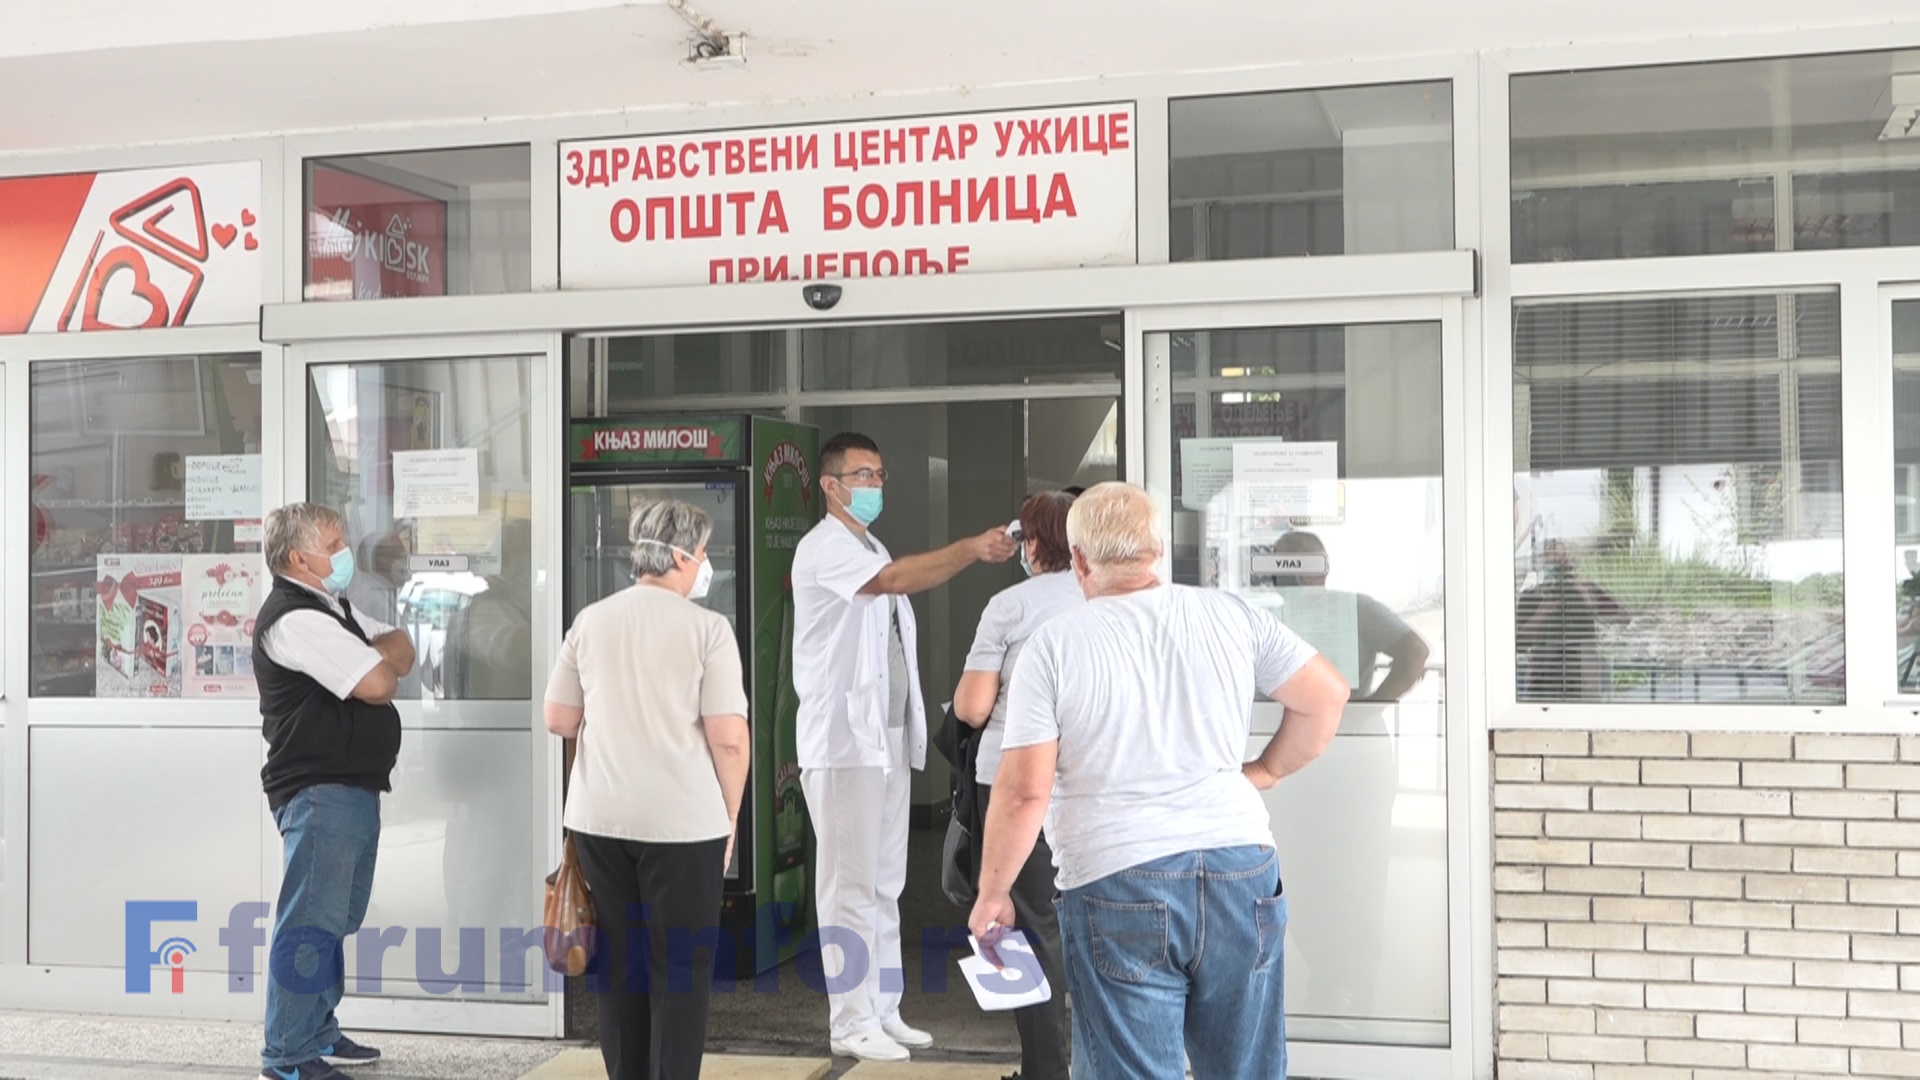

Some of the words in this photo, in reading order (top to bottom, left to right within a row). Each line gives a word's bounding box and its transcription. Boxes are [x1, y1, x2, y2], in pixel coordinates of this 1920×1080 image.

[566, 133, 818, 188] ЗДРАВСТВЕНИ
[834, 123, 978, 171] ЦЕНТАР
[994, 112, 1129, 157] УЖИЦЕ
[610, 190, 789, 243] ОПШТА
[823, 172, 1077, 231] БОЛНИЦА
[594, 430, 641, 450] КЊАЗ
[644, 428, 708, 449] МИЛОШ
[1275, 559, 1302, 568] УЛАЗ
